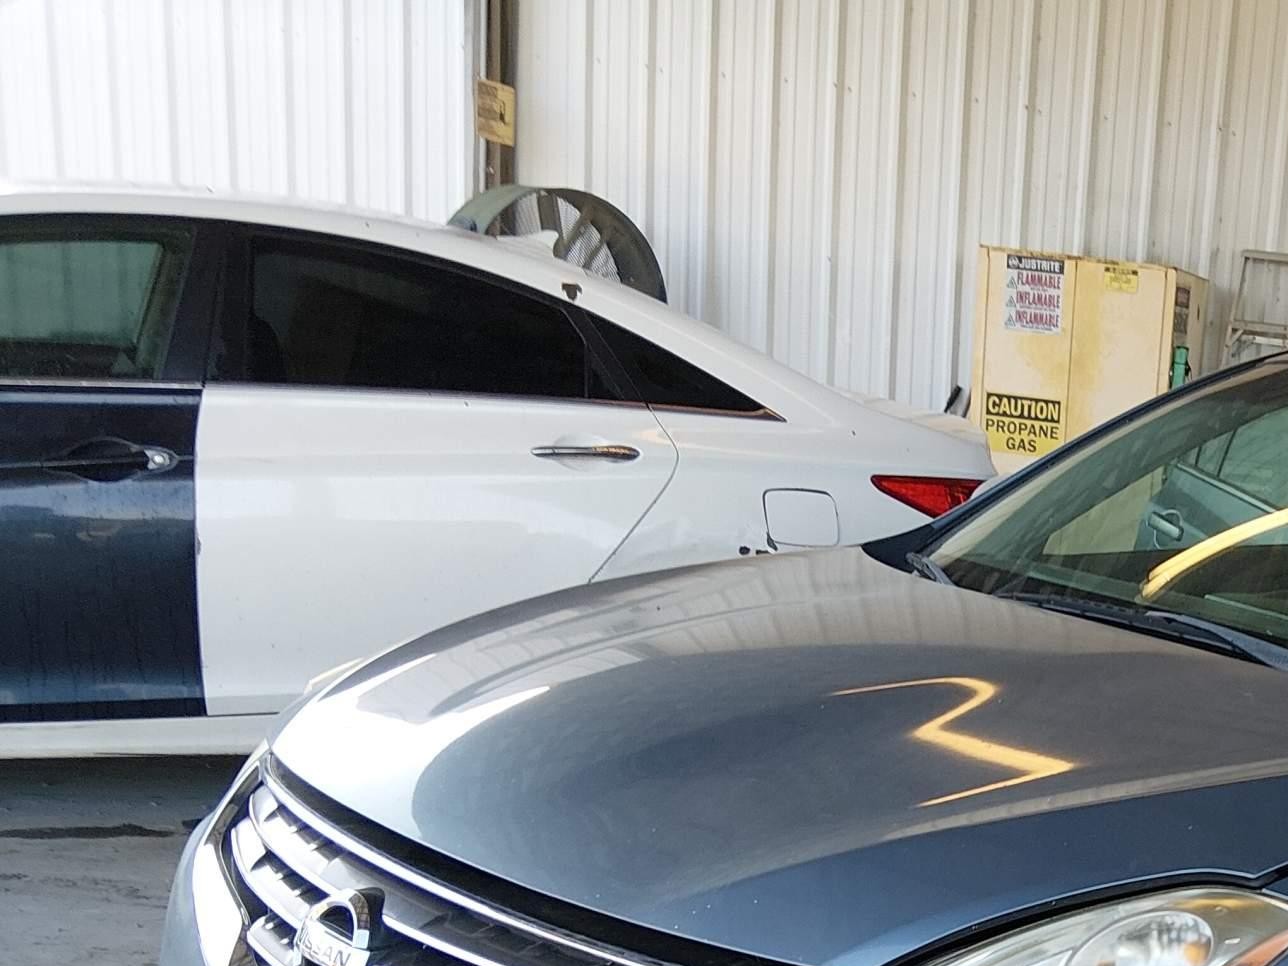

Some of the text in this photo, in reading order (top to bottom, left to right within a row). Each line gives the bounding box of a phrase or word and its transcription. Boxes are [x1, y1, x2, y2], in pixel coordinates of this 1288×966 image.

[1018, 258, 1060, 272] JUSTRITE
[1017, 271, 1061, 289] FLAMMABLE
[1016, 291, 1060, 309] INFLAMABLE
[1015, 310, 1059, 328] INFLAMMABLE
[987, 395, 1059, 420] CAUTION
[985, 418, 1060, 440] PROPANE
[1005, 436, 1037, 453] GAS
